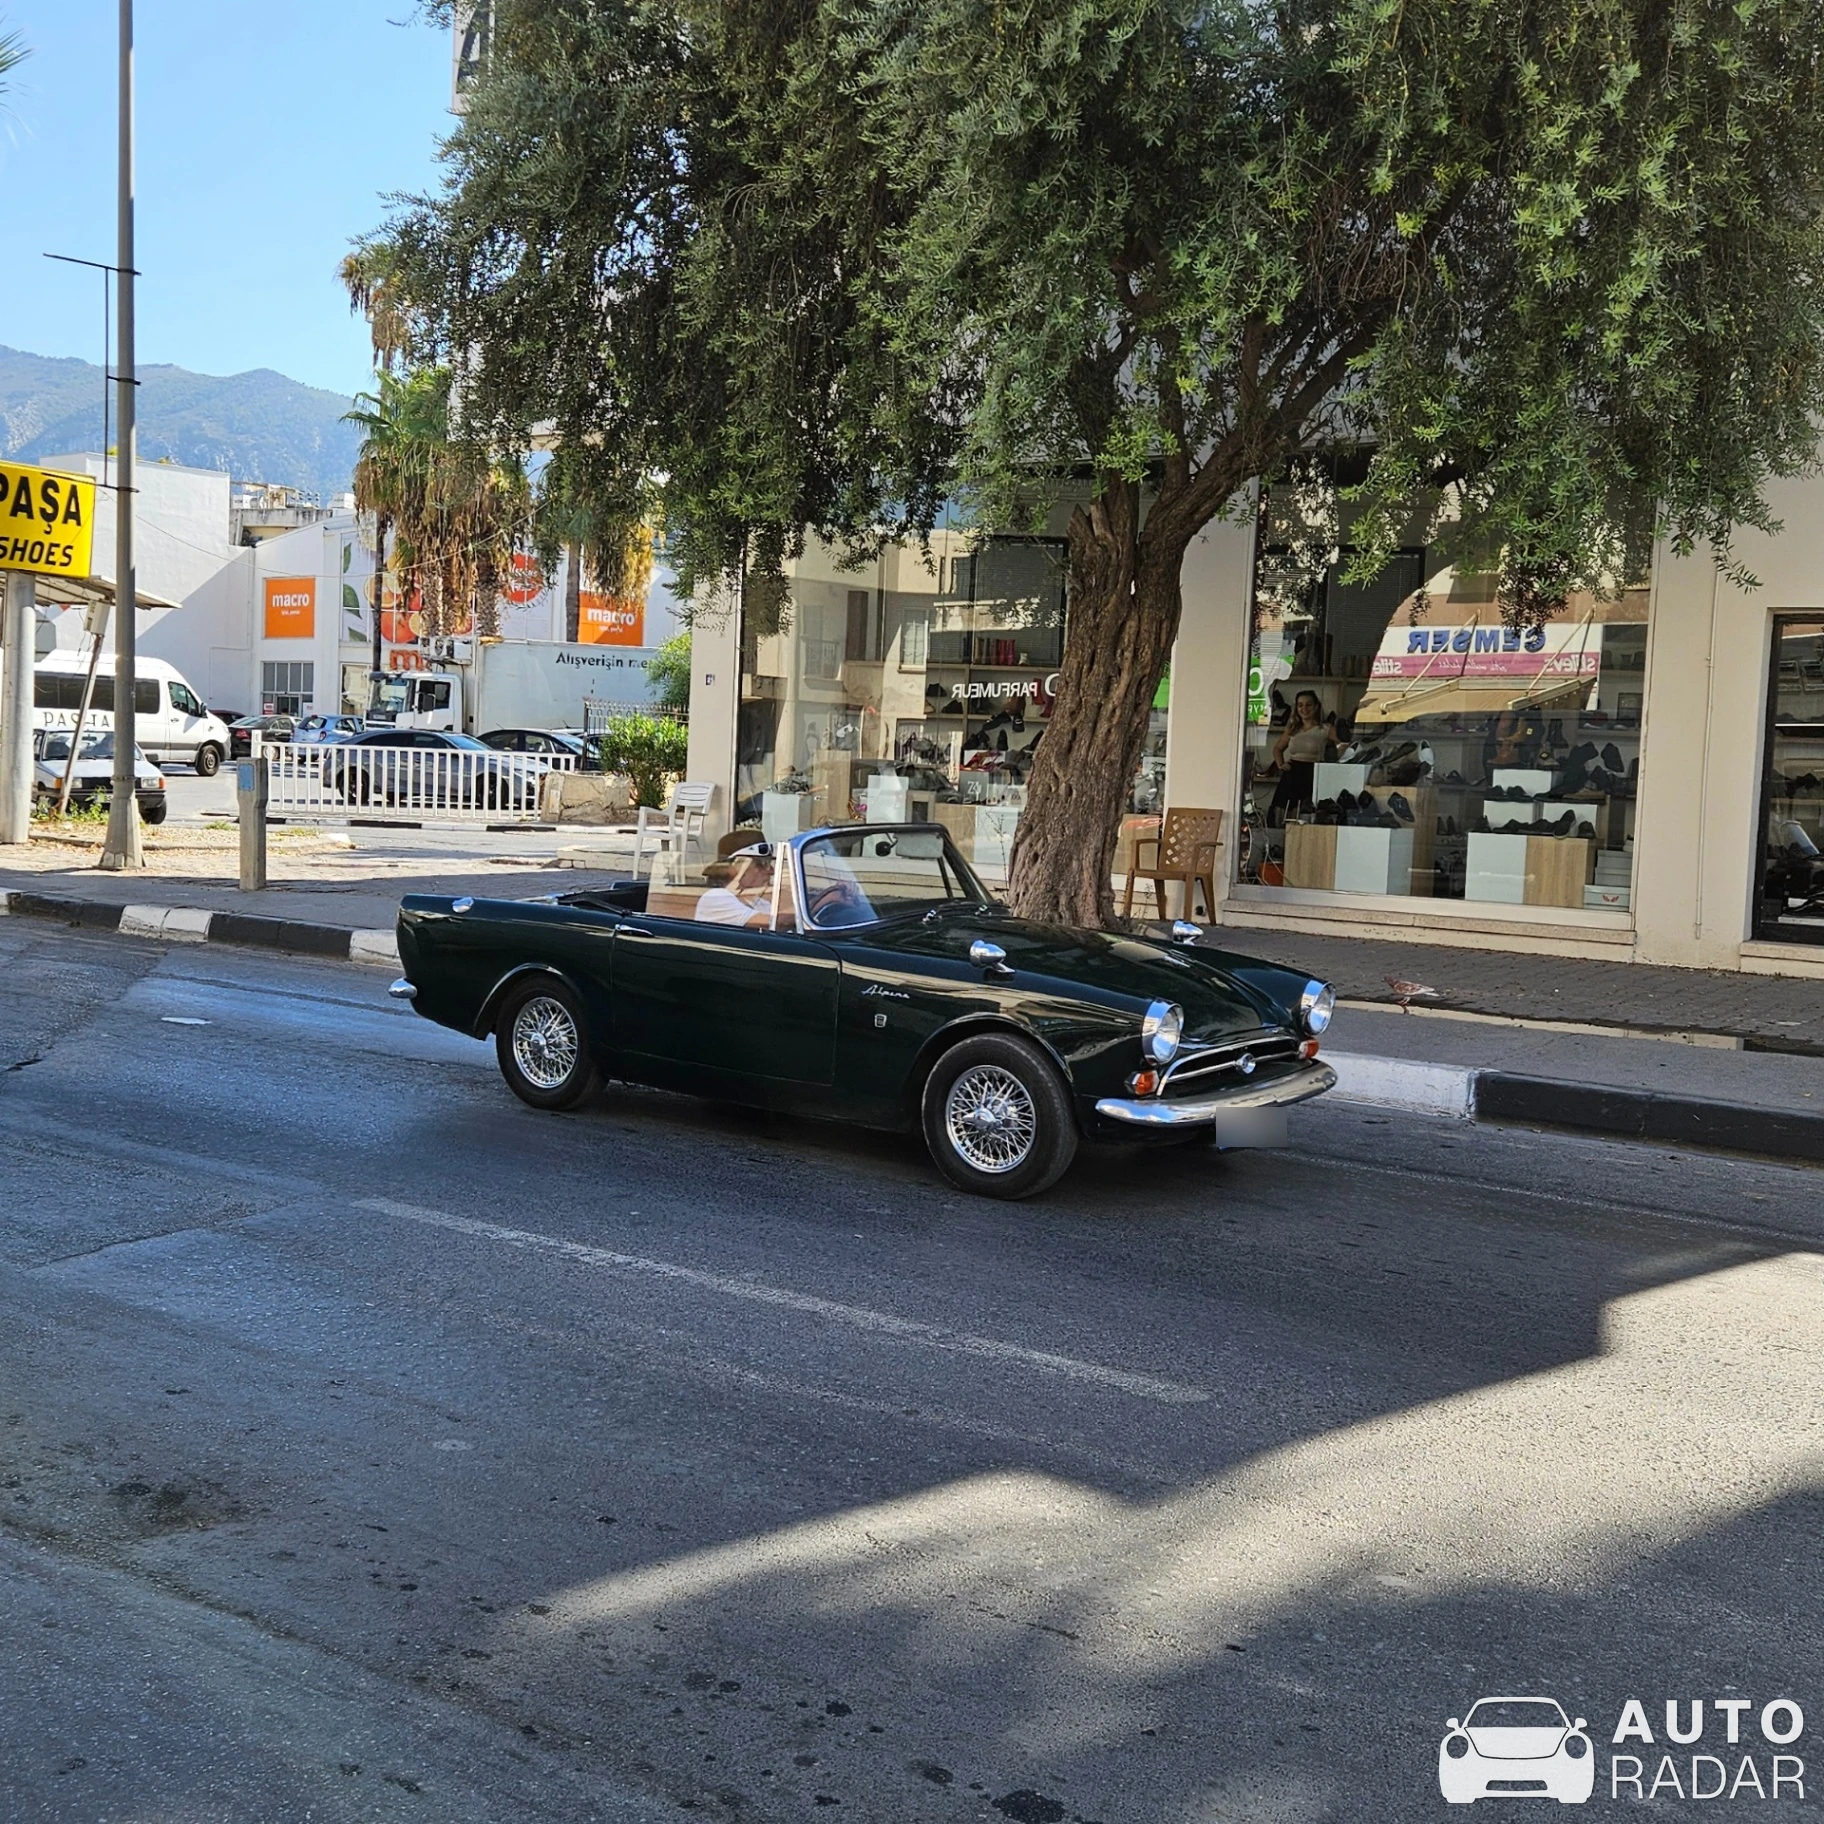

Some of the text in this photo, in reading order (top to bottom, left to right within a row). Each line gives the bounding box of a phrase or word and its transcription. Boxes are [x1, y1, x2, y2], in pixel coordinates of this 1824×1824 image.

[0, 536, 74, 567] SHOES
[272, 593, 310, 607] macro
[587, 607, 635, 626] macro
[556, 652, 623, 670] Alışverişin
